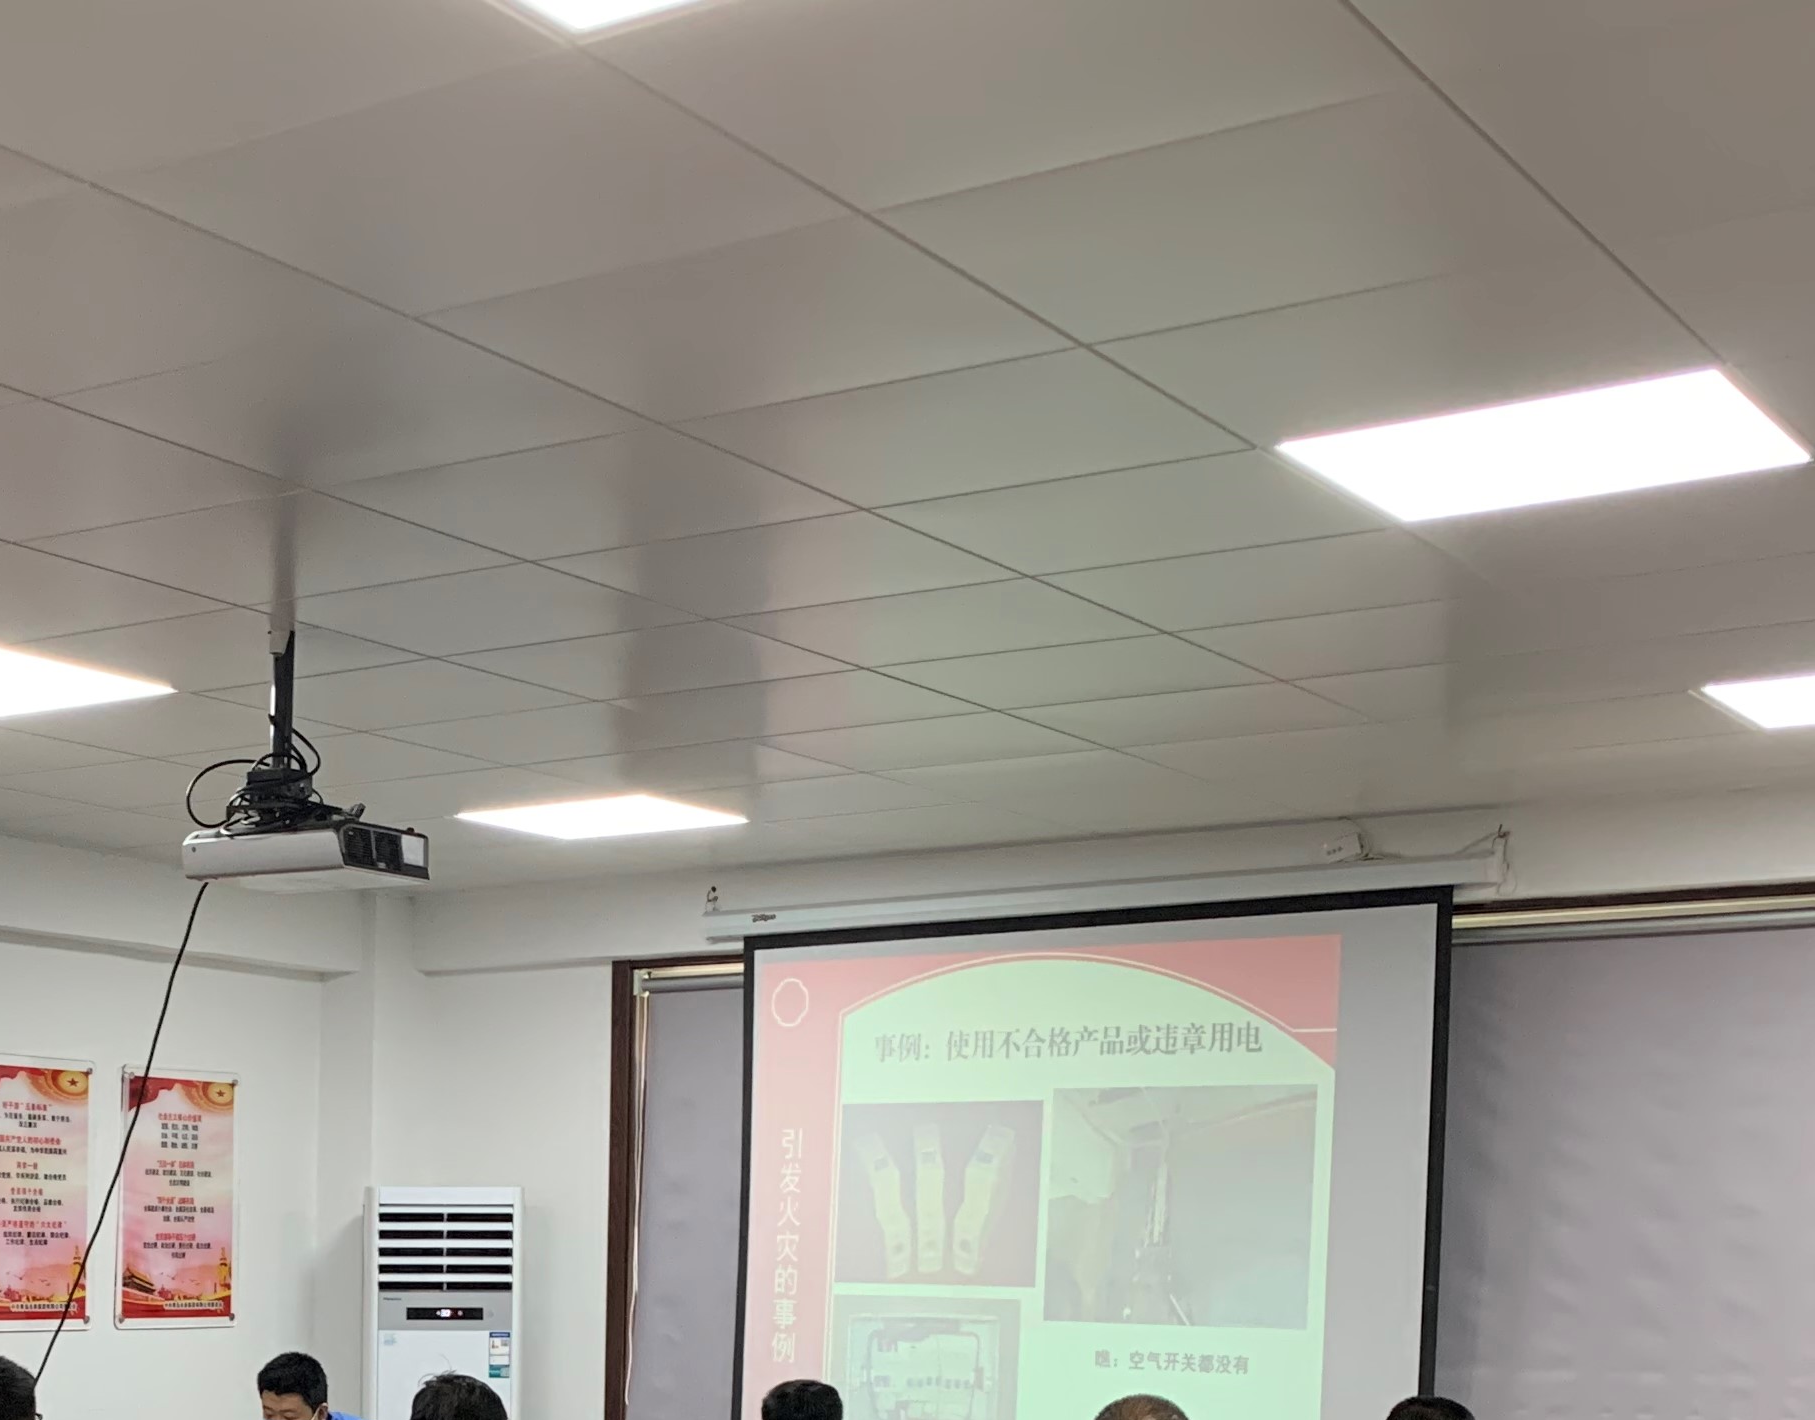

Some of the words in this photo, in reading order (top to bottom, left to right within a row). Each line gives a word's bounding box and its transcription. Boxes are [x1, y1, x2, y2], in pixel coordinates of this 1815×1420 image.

[874, 1021, 1263, 1063] 事例：使用不合格产品或违章用电
[772, 1128, 803, 1364] 引发火灾的事例
